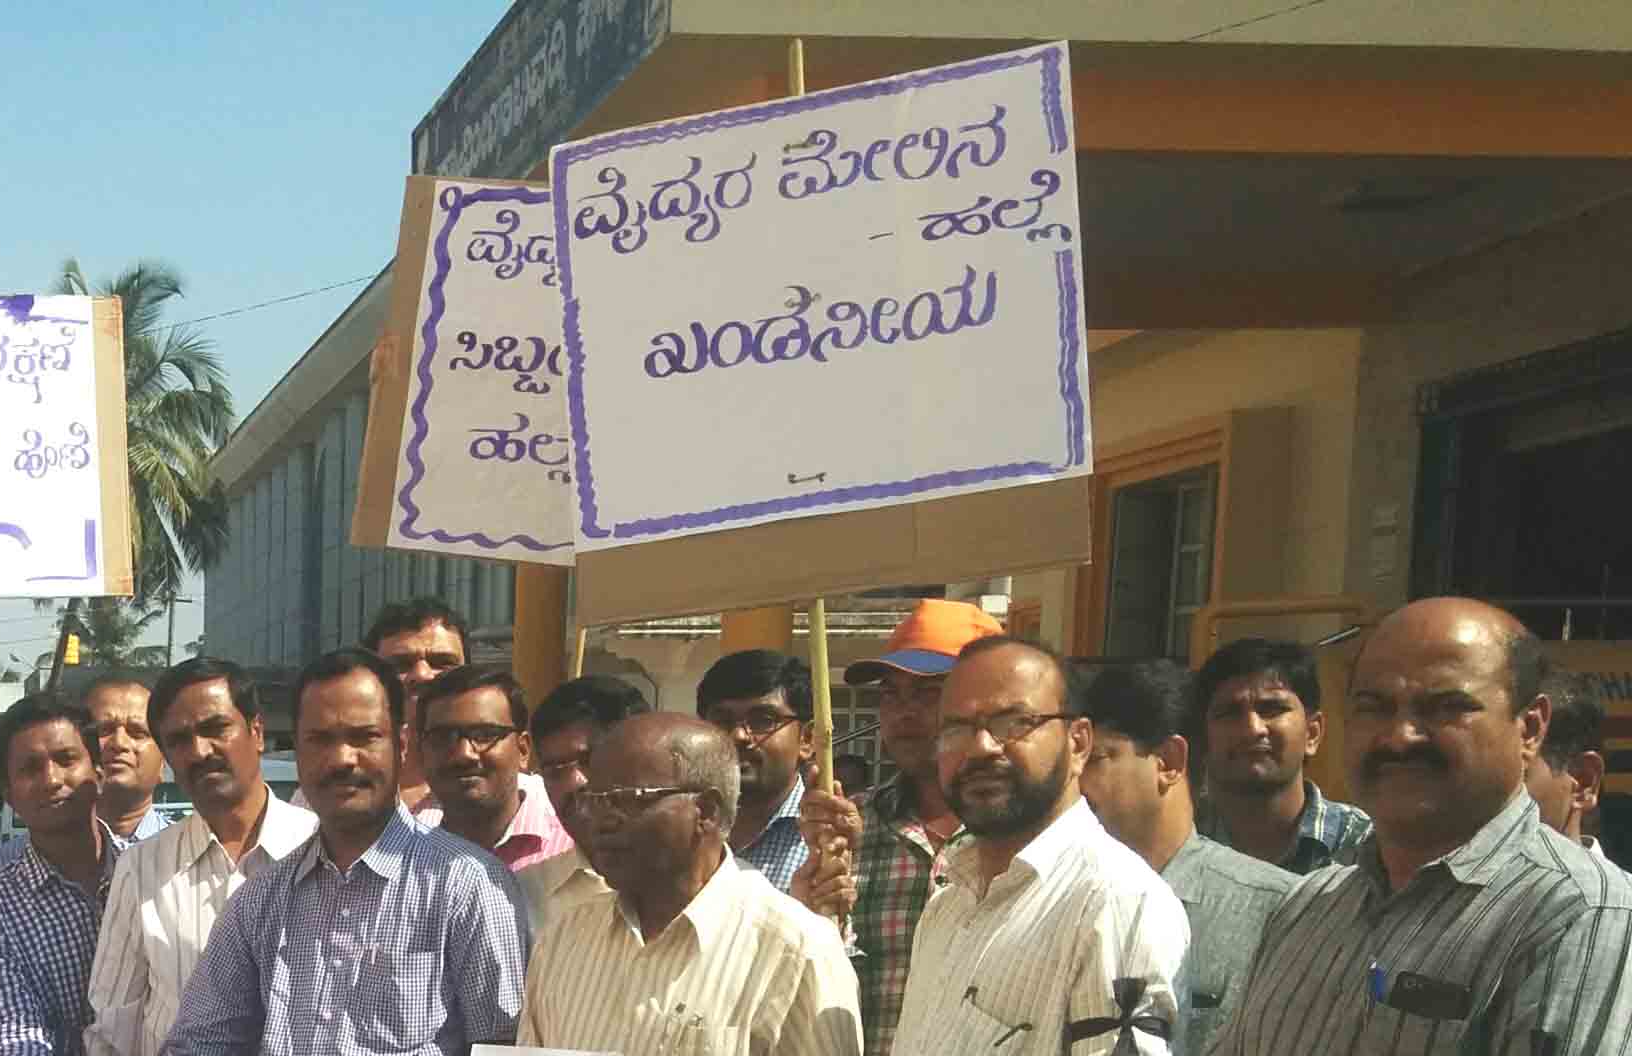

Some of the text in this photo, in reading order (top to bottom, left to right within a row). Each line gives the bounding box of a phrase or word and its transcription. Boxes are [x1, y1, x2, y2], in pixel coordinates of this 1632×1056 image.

[574, 104, 1007, 254] ವೈದ್ಯರ ಮೇಲಿನ
[917, 168, 1073, 242] ಹಲ್ಲೆ
[466, 209, 558, 287] ವೈದ್ಯ
[643, 264, 998, 379] ಖಂಡನೀಯ
